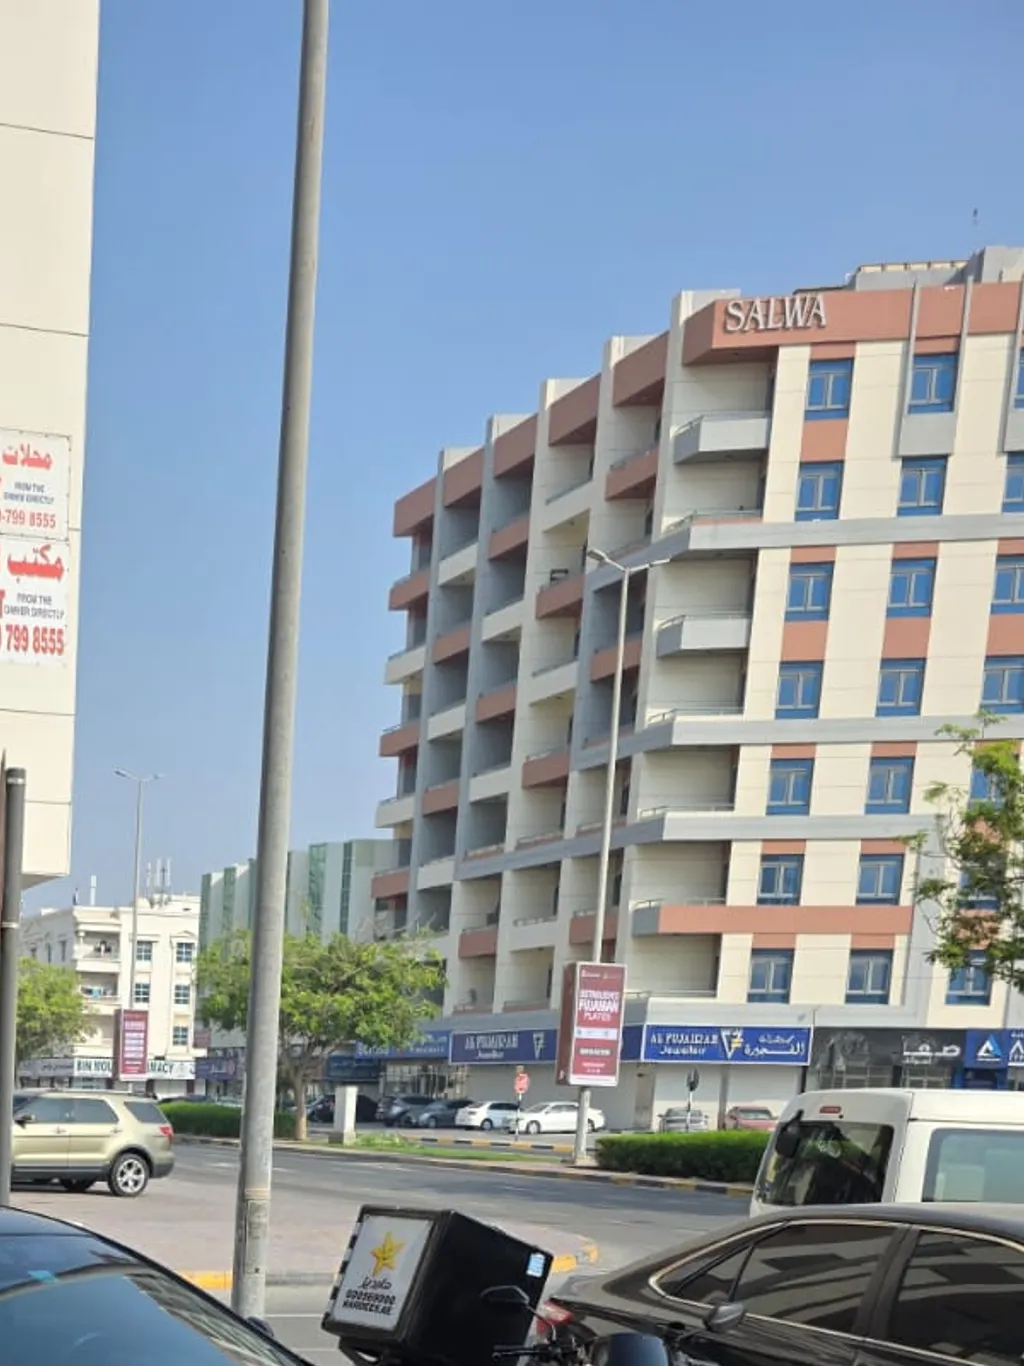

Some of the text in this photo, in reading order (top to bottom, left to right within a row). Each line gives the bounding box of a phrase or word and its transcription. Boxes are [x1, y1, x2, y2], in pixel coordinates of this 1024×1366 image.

[725, 294, 826, 332] SALWA
[29, 511, 56, 529] 8555
[7, 544, 64, 583] مكتب
[5, 624, 28, 652] 799
[32, 626, 64, 655] 8555
